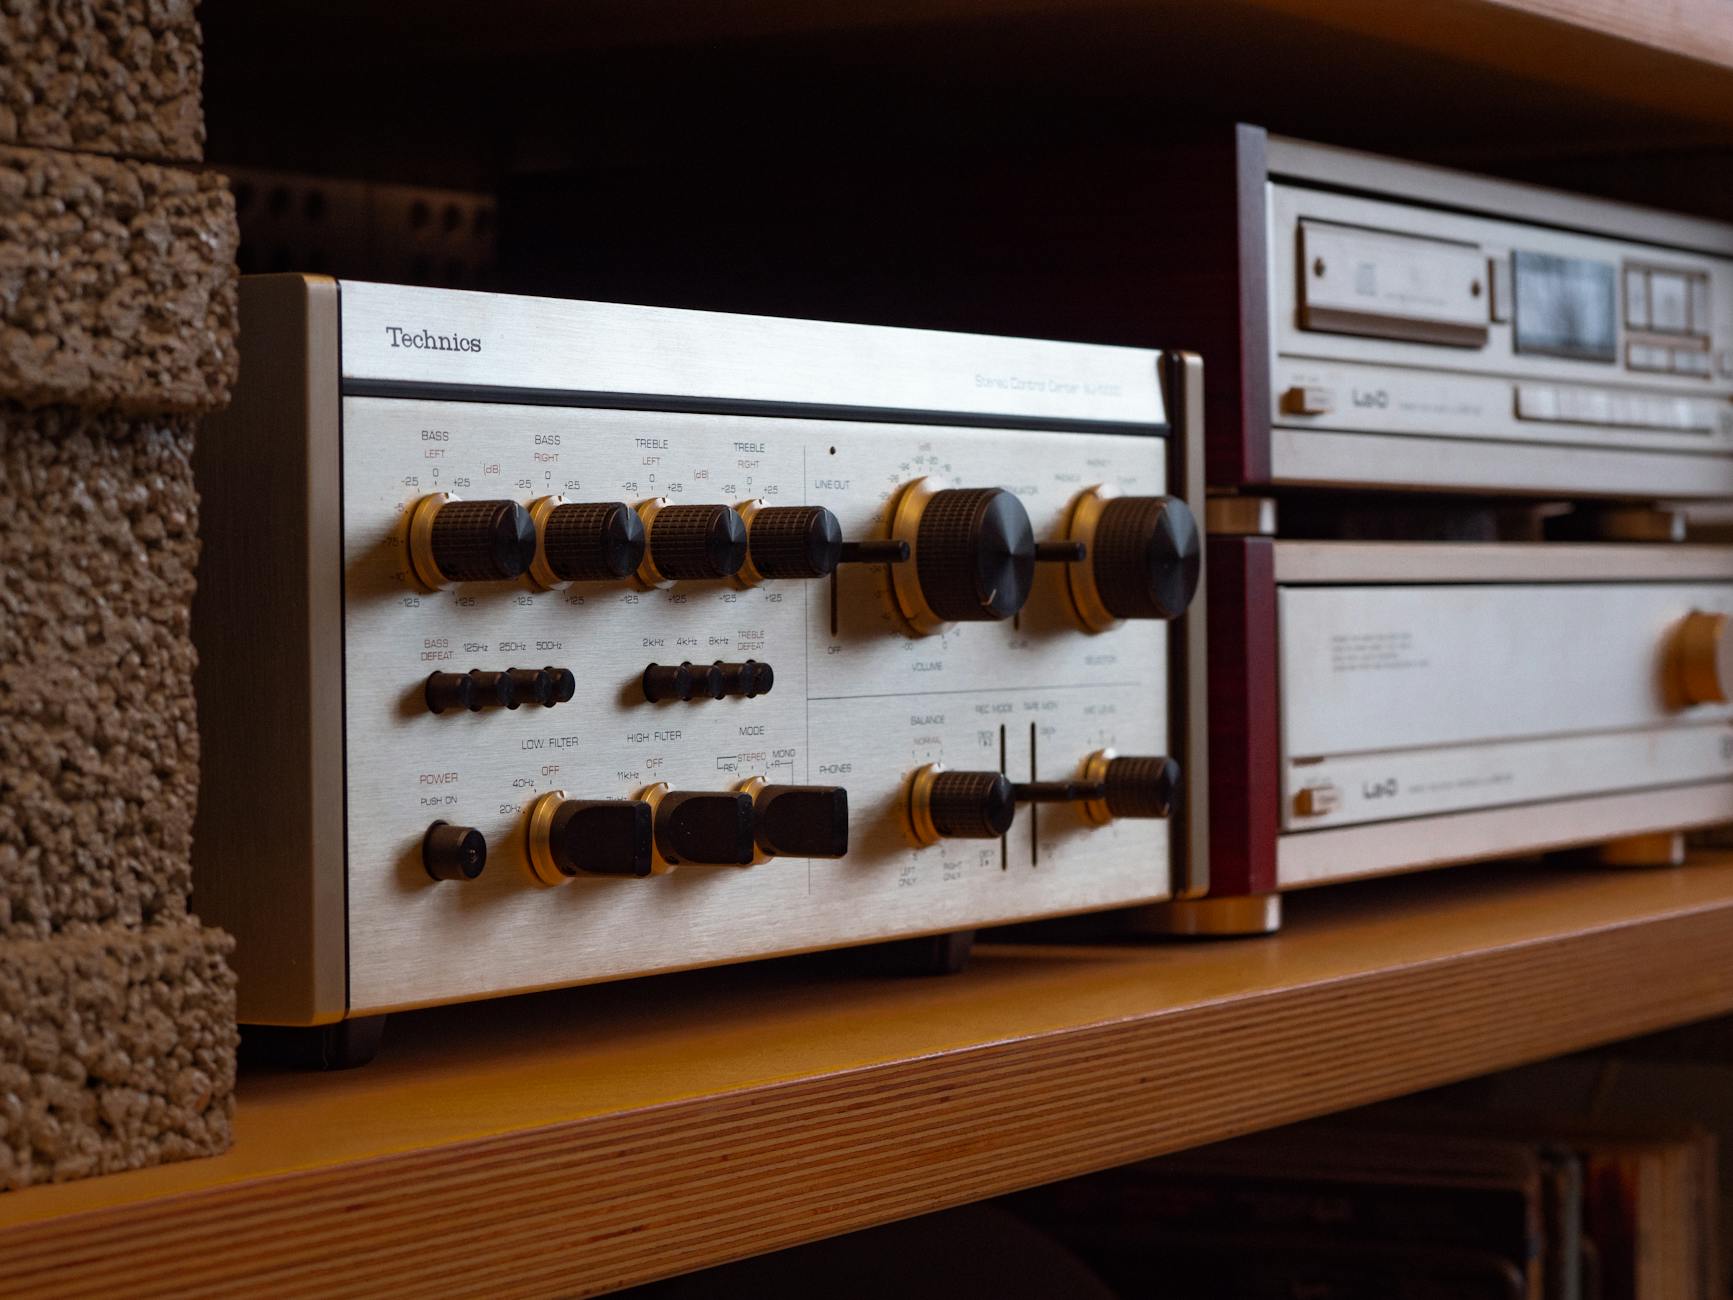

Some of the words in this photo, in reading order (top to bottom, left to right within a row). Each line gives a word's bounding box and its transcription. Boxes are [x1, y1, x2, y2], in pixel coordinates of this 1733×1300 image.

[386, 327, 482, 352] Technics
[421, 431, 449, 441] BASS
[534, 435, 560, 445] BASS
[635, 438, 669, 449] TREBLE
[733, 443, 765, 453] TREBLE
[424, 450, 445, 459] LEFT
[534, 453, 559, 462] RIGHT
[642, 456, 660, 466] LEFT
[737, 460, 760, 469] RIGHT
[433, 468, 439, 477] 0
[545, 471, 551, 480] 0
[649, 474, 655, 482] 0
[814, 479, 832, 489] LINE
[834, 480, 850, 490] OUT
[737, 630, 765, 639] TREBLE
[424, 639, 448, 648] BASS
[499, 642, 526, 651] 250Hz
[536, 641, 562, 651] 500Hz
[642, 637, 664, 647] 2kHz
[676, 637, 698, 646] 4kHz
[737, 642, 764, 651] DEFEAT
[464, 642, 488, 652] 125Hz
[827, 646, 841, 655] OFF
[421, 651, 454, 661] DEFEAT
[912, 661, 943, 672] VOLUME
[910, 715, 945, 726] BALANCE
[739, 725, 765, 736] MODE
[627, 732, 650, 743] HIGH
[654, 730, 682, 741] FILTER
[521, 739, 544, 750] LOW
[550, 736, 579, 748] FILTER
[737, 752, 766, 763] STEREO
[772, 748, 796, 758] MONO
[646, 758, 663, 769] OFF
[723, 763, 738, 772] REV
[819, 763, 852, 774] PHONES
[541, 765, 560, 776] OFF
[617, 771, 639, 780] 11kHz
[419, 772, 458, 785] POWER
[512, 778, 535, 788] 40Hz
[420, 797, 442, 806] PUSH
[445, 796, 458, 804] ON
[500, 804, 521, 815] 20Hz
